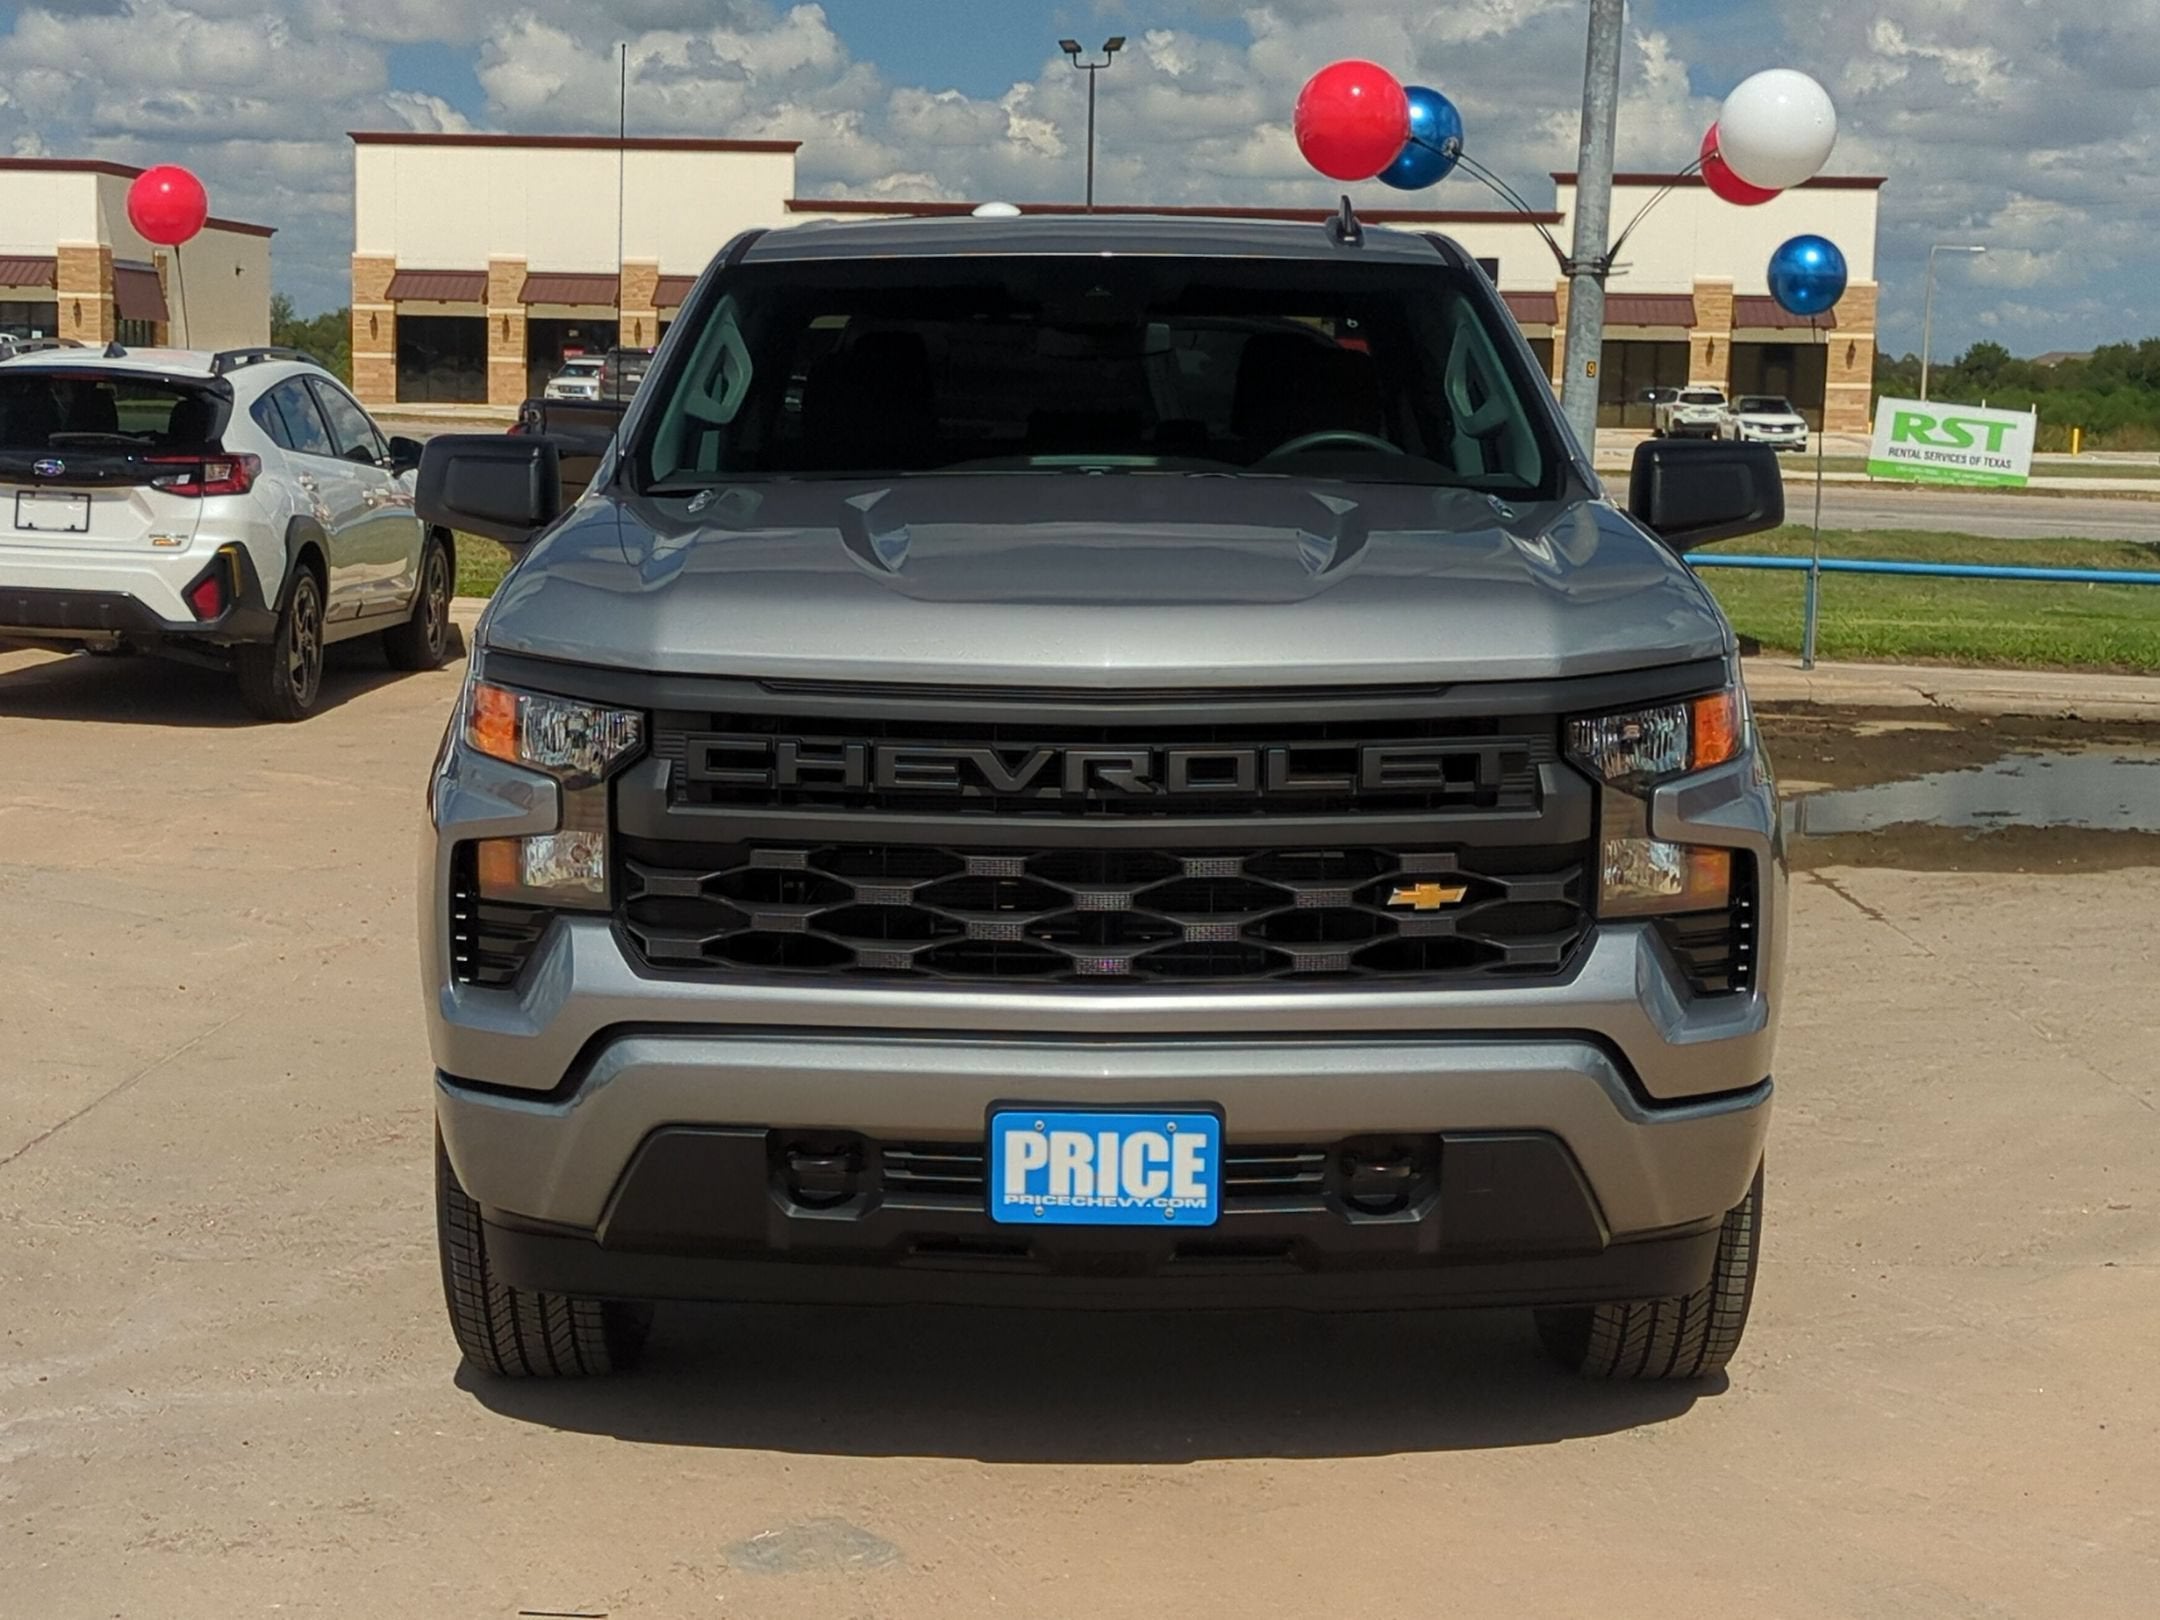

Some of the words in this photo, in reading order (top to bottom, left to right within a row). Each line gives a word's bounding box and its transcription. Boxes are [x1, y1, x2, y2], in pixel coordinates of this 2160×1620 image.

[1891, 411, 2017, 452] RST
[1888, 447, 1921, 460] RENTAL
[1924, 451, 1967, 465] SERVICES
[1969, 456, 1981, 466] OF
[1984, 457, 2012, 469] TEXAS
[688, 739, 1529, 795] CHEVROLET
[1004, 1130, 1207, 1198] PRICE
[1004, 1195, 1207, 1208] PRICECHEVY.COM
